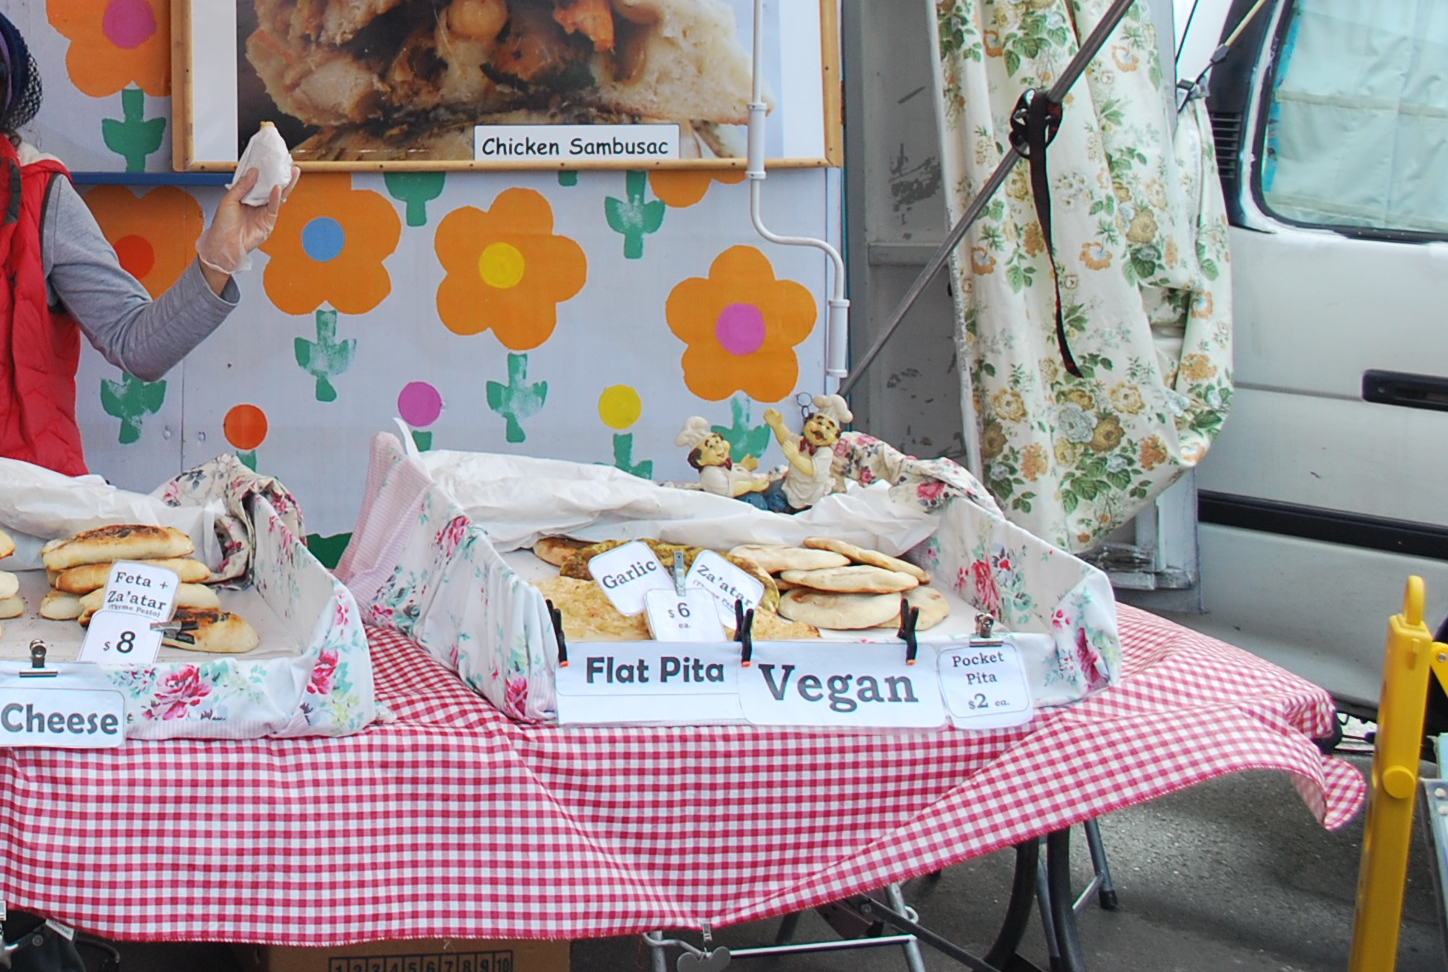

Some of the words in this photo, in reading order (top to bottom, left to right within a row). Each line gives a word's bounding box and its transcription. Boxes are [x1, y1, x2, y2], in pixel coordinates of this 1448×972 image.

[482, 137, 560, 156] Chicken
[569, 137, 669, 156] Sambusac
[114, 571, 151, 587] Feta
[159, 581, 168, 589] +
[602, 560, 658, 589] Garlic
[697, 564, 753, 606] Za'atar
[107, 590, 166, 610] Za'atar
[586, 656, 649, 684] Flat
[660, 656, 724, 683] Pita
[952, 651, 1005, 667] Pocket
[758, 663, 919, 713] Vegan
[965, 672, 998, 685] Pita
[1, 702, 119, 735] Cheese
